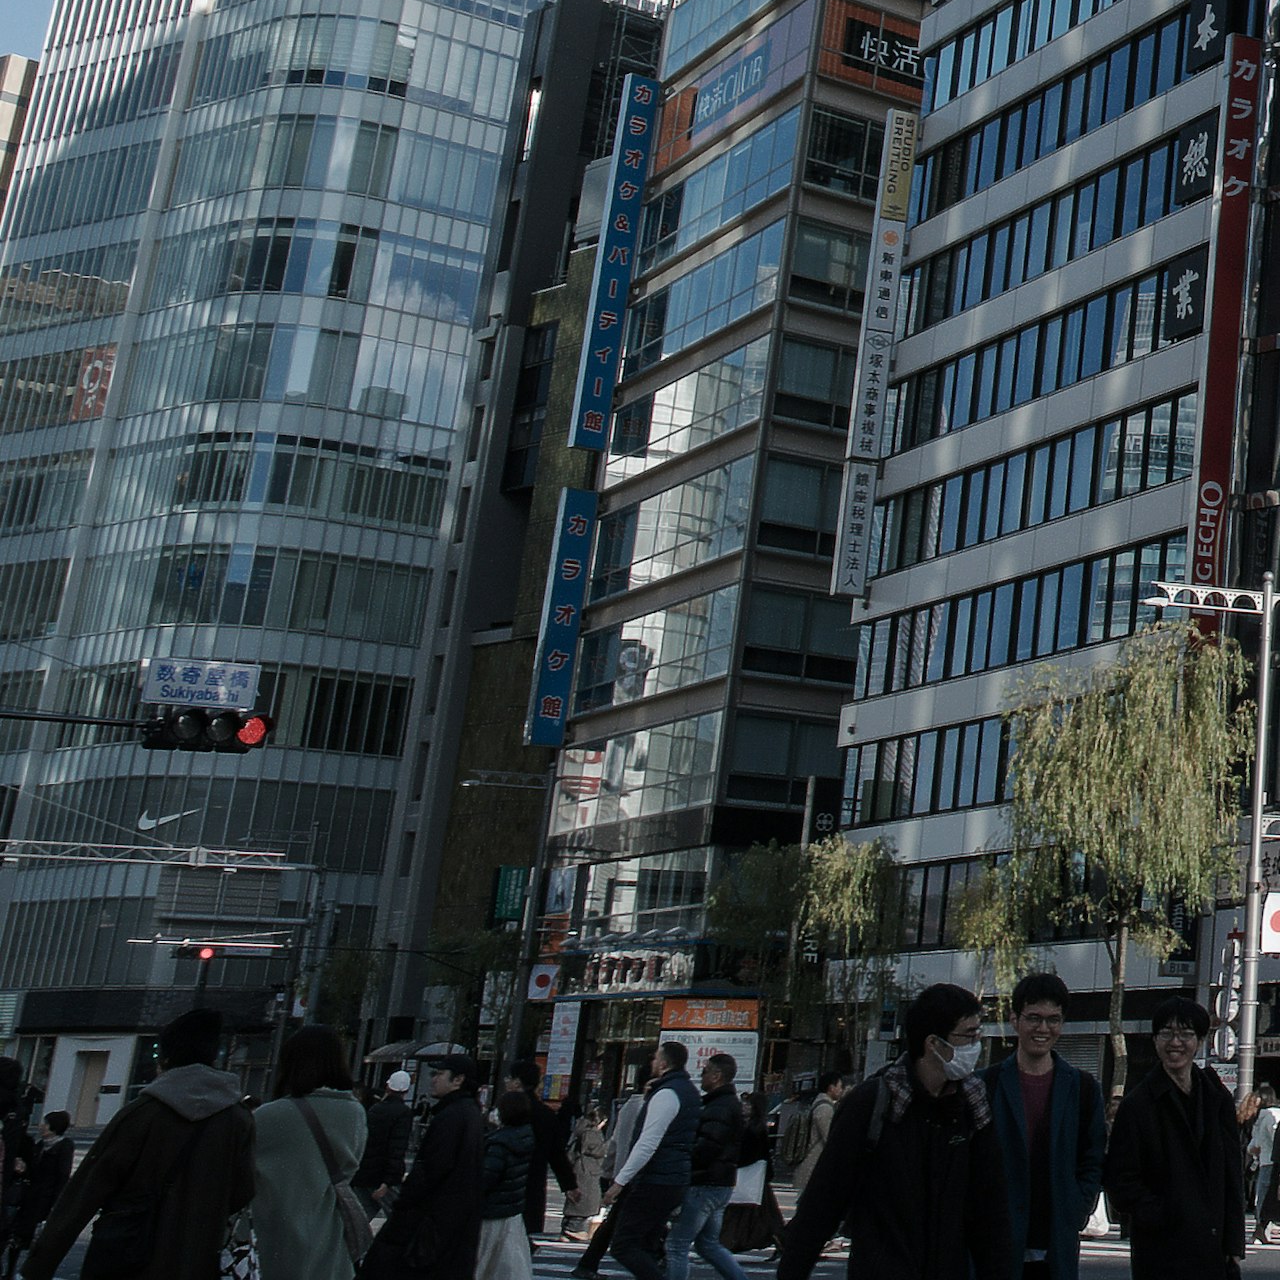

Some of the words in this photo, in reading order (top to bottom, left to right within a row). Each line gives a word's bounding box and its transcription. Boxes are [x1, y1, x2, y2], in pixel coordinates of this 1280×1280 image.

[859, 30, 921, 76] 快活
[887, 116, 903, 194] BREITLING
[901, 118, 916, 171] STUDIO
[1225, 59, 1258, 197] カラオケ
[845, 472, 870, 588] 銀座税理士法人
[1197, 480, 1224, 557] ECHO
[541, 514, 588, 719] カラオケ館
[156, 665, 250, 689] 数寄屋橋
